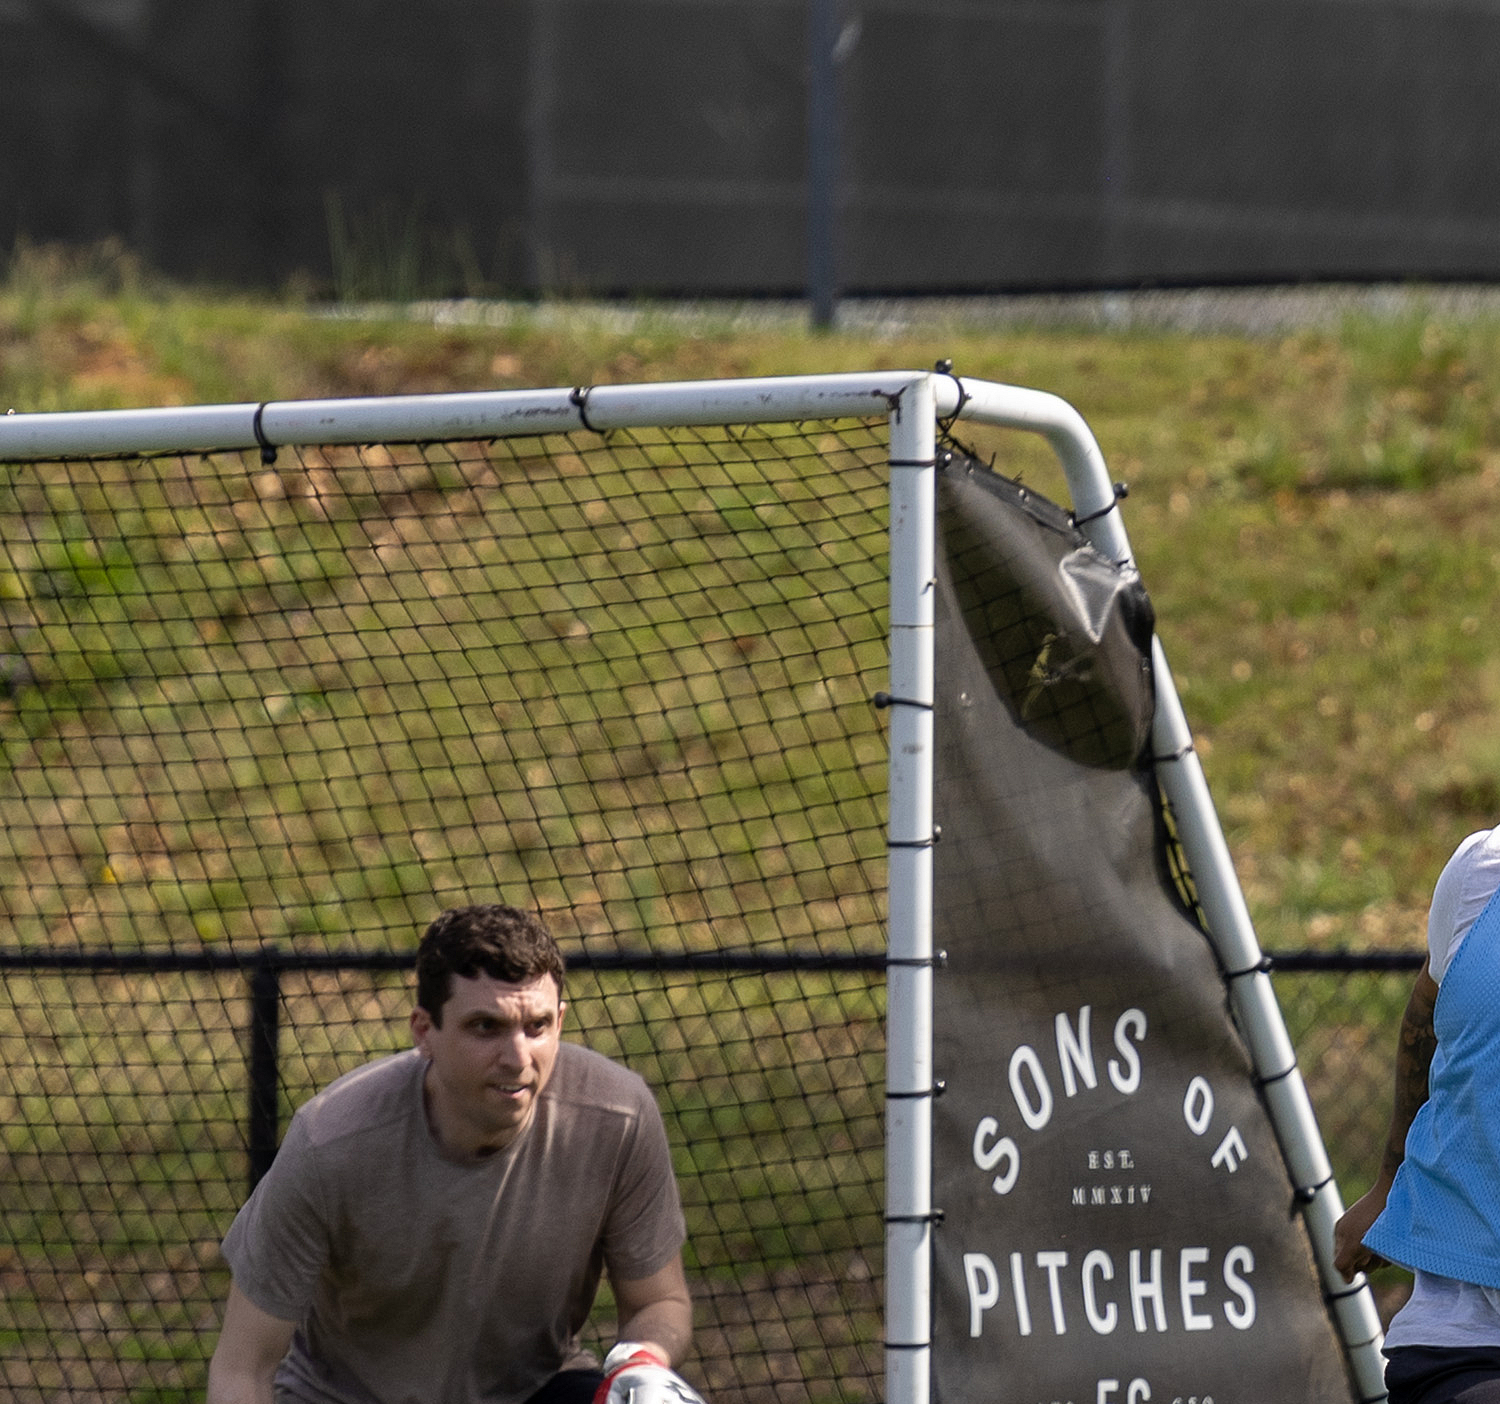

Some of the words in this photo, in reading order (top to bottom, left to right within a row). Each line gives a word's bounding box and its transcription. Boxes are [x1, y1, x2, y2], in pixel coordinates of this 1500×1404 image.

[973, 1005, 1147, 1195] SONS
[1183, 1075, 1249, 1173] OF
[1087, 1149, 1136, 1170] EST.
[1071, 1185, 1152, 1206] MMXIV
[963, 1245, 1257, 1338] PITCHES
